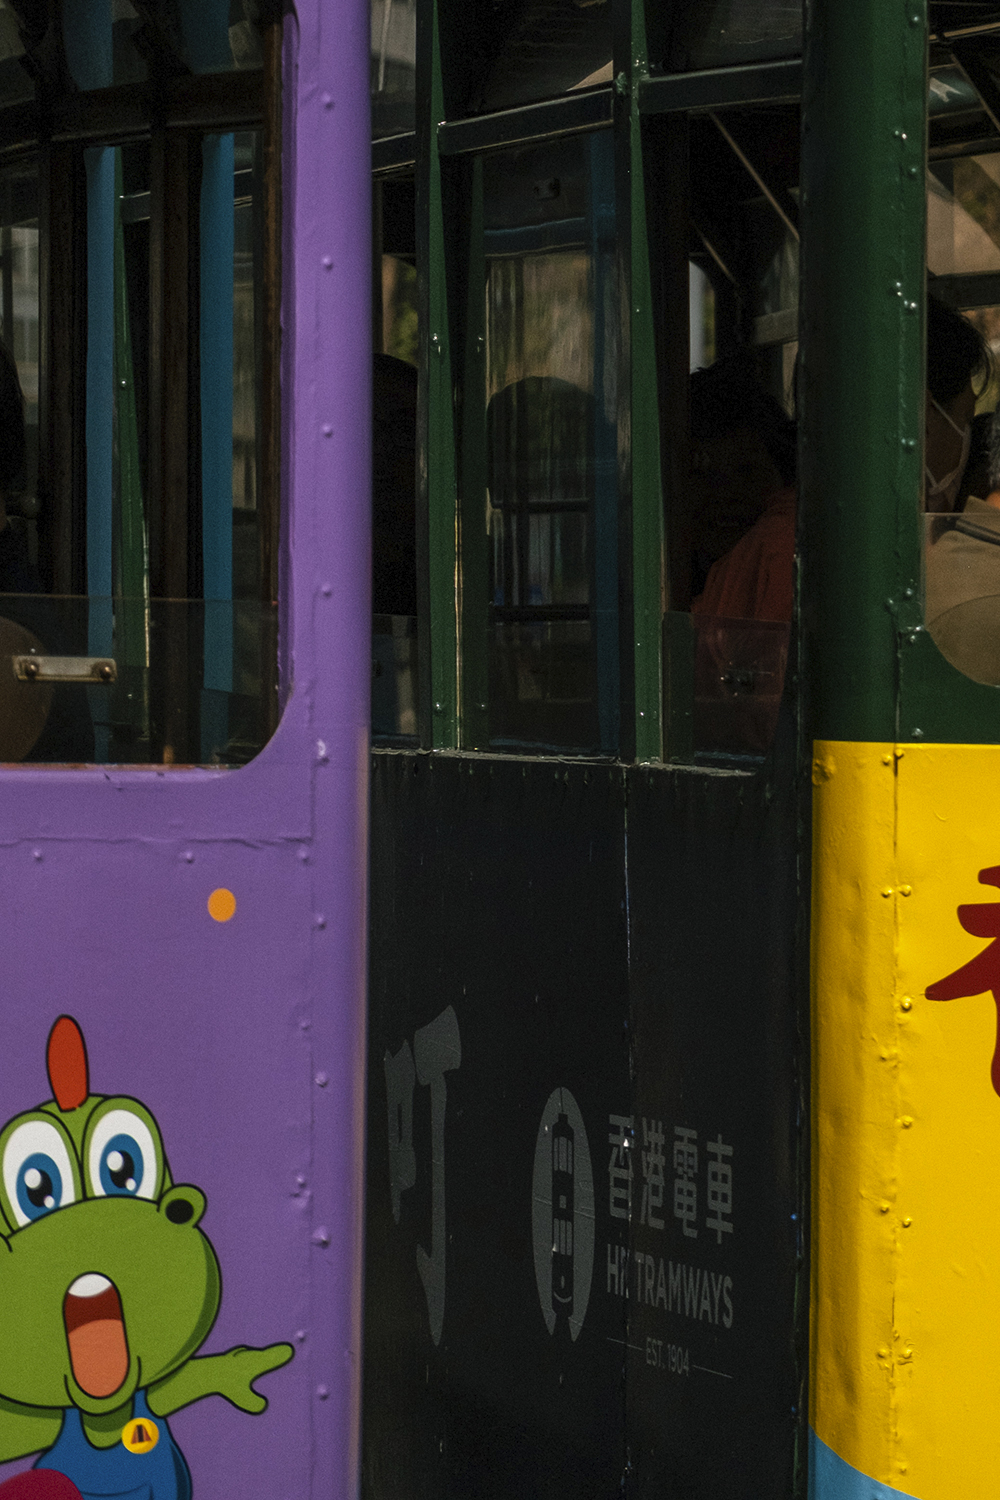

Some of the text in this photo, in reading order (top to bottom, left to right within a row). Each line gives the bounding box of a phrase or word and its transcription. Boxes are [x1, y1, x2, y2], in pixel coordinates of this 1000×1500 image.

[608, 1114, 734, 1245] 香港電車
[635, 1251, 734, 1329] TRAMWAYS
[667, 1343, 690, 1377] 1904
